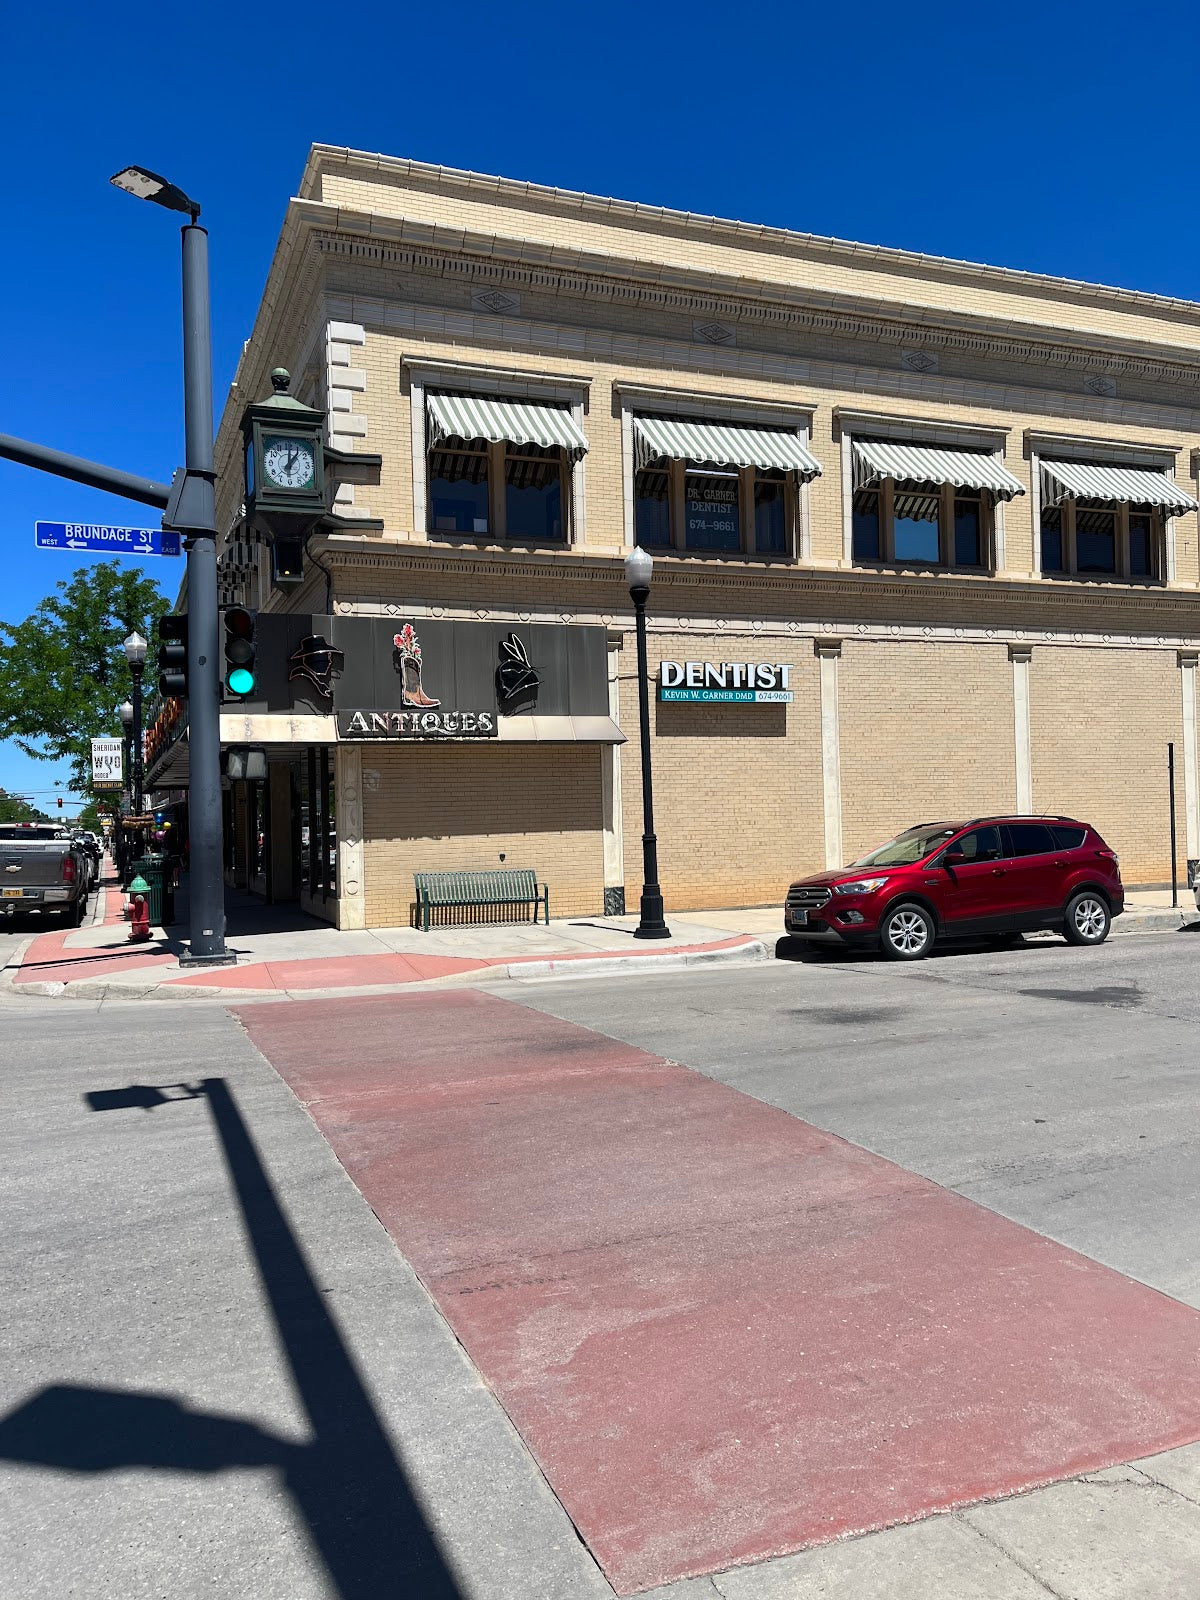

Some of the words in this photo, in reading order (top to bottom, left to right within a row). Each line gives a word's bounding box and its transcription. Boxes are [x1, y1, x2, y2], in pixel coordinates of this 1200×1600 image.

[270, 450, 278, 458] 10
[302, 452, 308, 460] 2
[268, 459, 274, 467] 9
[305, 461, 311, 470] 3
[271, 468, 277, 476] 8
[287, 478, 293, 486] 6
[687, 487, 700, 499] DR.
[703, 489, 736, 502] GARNER
[691, 501, 732, 514] DENTIST
[689, 518, 736, 532] 674-9661
[65, 524, 133, 543] BRUNDAGE
[139, 530, 154, 543] ST
[41, 538, 58, 546] WEST
[161, 546, 177, 554] EAST
[660, 661, 794, 689] DENTIST
[664, 690, 689, 699] KEVIN
[690, 690, 701, 700] W.
[702, 691, 734, 700] GARNER
[735, 692, 753, 700] DMD
[758, 692, 791, 701] 674-9661
[346, 711, 493, 735] ANTIQUES
[93, 744, 121, 752] SHERIDAN
[94, 756, 121, 774] WYO
